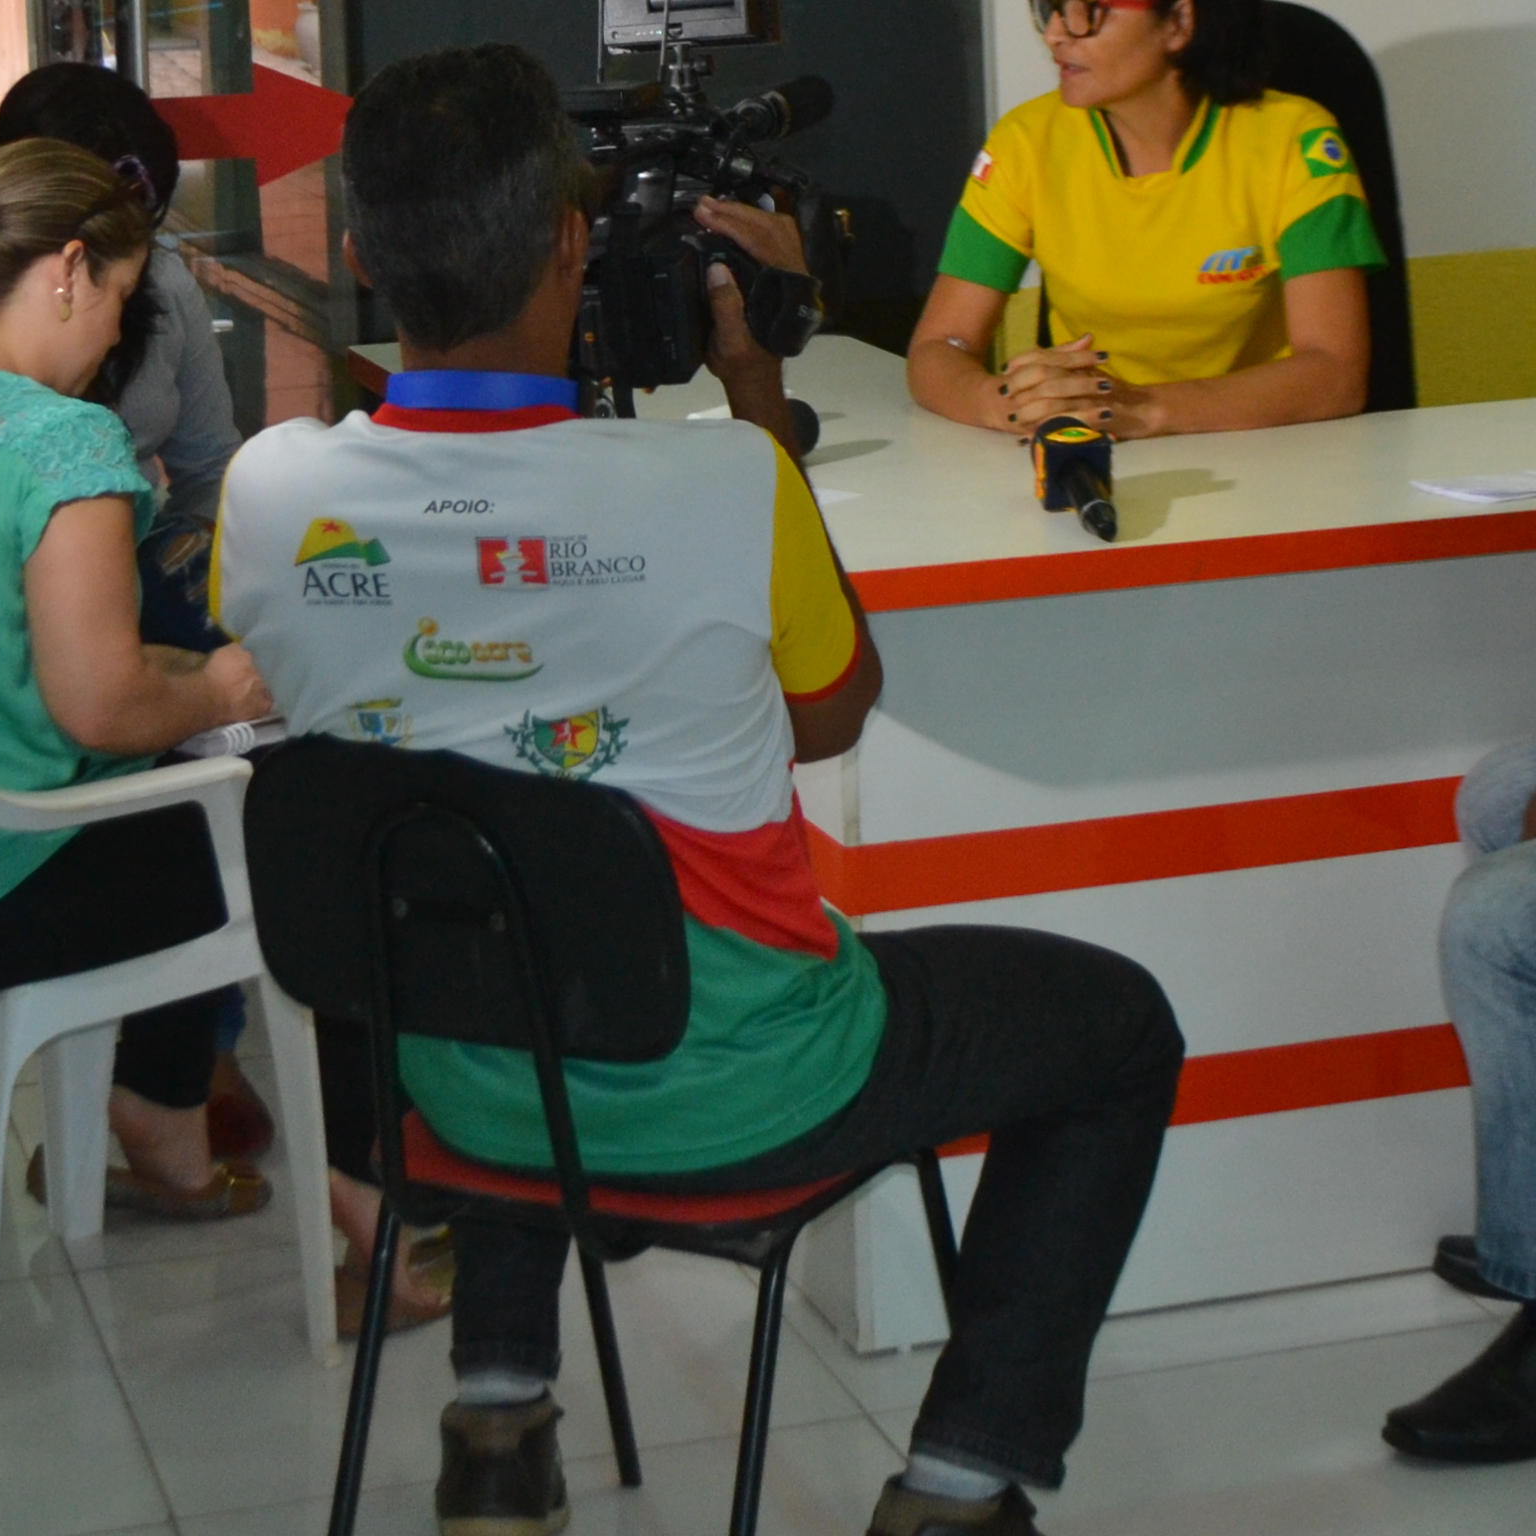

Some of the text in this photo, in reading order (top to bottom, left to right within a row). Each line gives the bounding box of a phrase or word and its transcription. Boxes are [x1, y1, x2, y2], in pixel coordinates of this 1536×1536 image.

[424, 499, 496, 515] APOIO:
[549, 541, 588, 559] RIO
[550, 555, 646, 577] BRANCO
[611, 574, 646, 584] LUGAR
